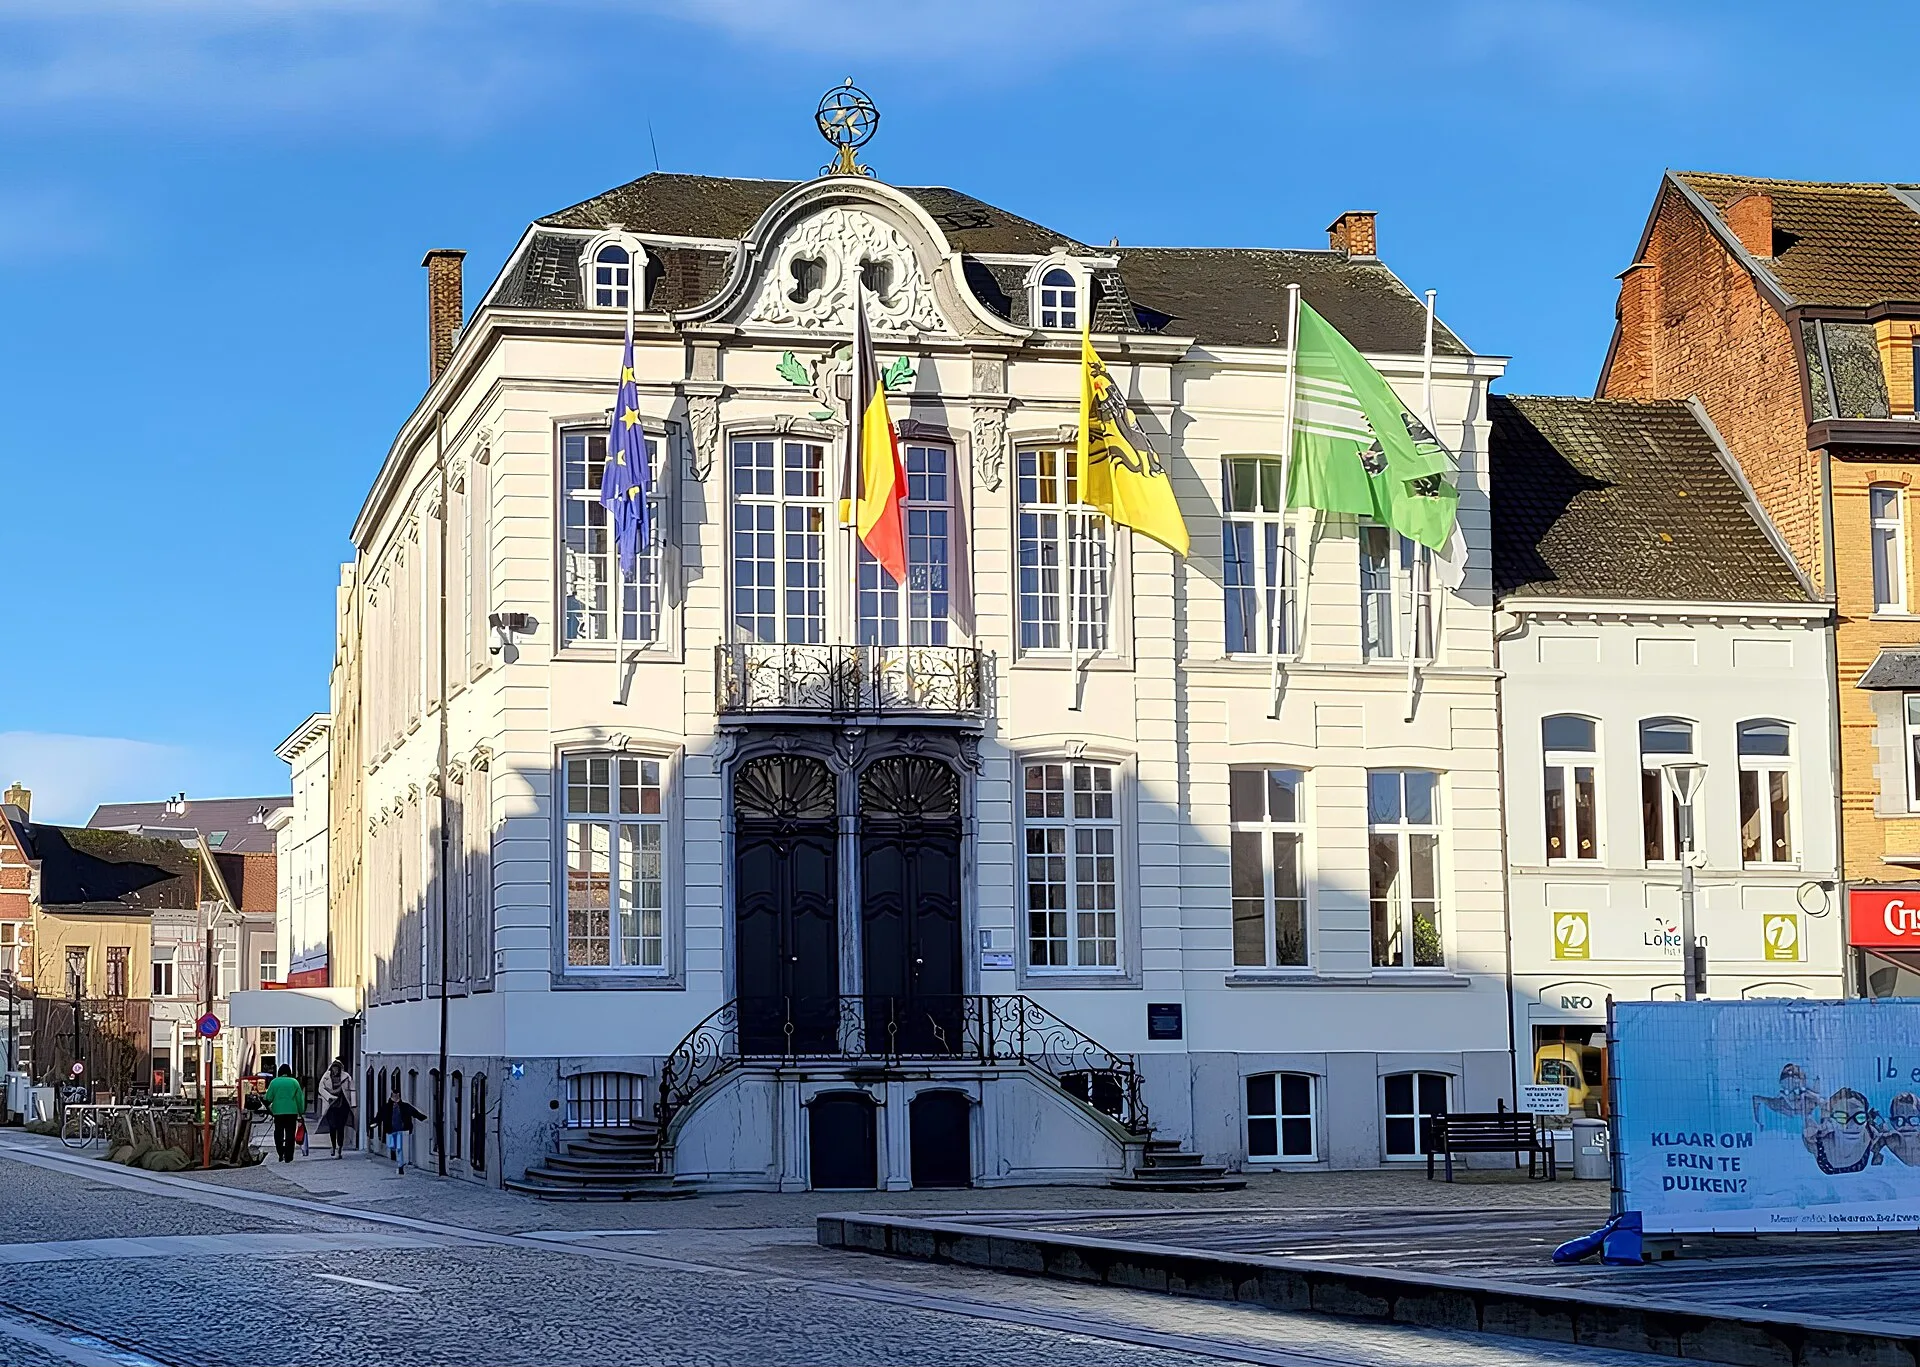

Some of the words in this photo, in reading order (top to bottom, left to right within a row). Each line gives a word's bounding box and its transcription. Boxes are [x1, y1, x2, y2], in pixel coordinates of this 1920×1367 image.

[1644, 931, 1708, 947] Loken
[1561, 996, 1592, 1009] INFO
[1651, 1132, 1716, 1148] KLAAR
[1720, 1132, 1753, 1148] OM
[1666, 1153, 1714, 1170] ERIN
[1717, 1157, 1741, 1172] TE
[1662, 1175, 1747, 1193] DUIKEN?
